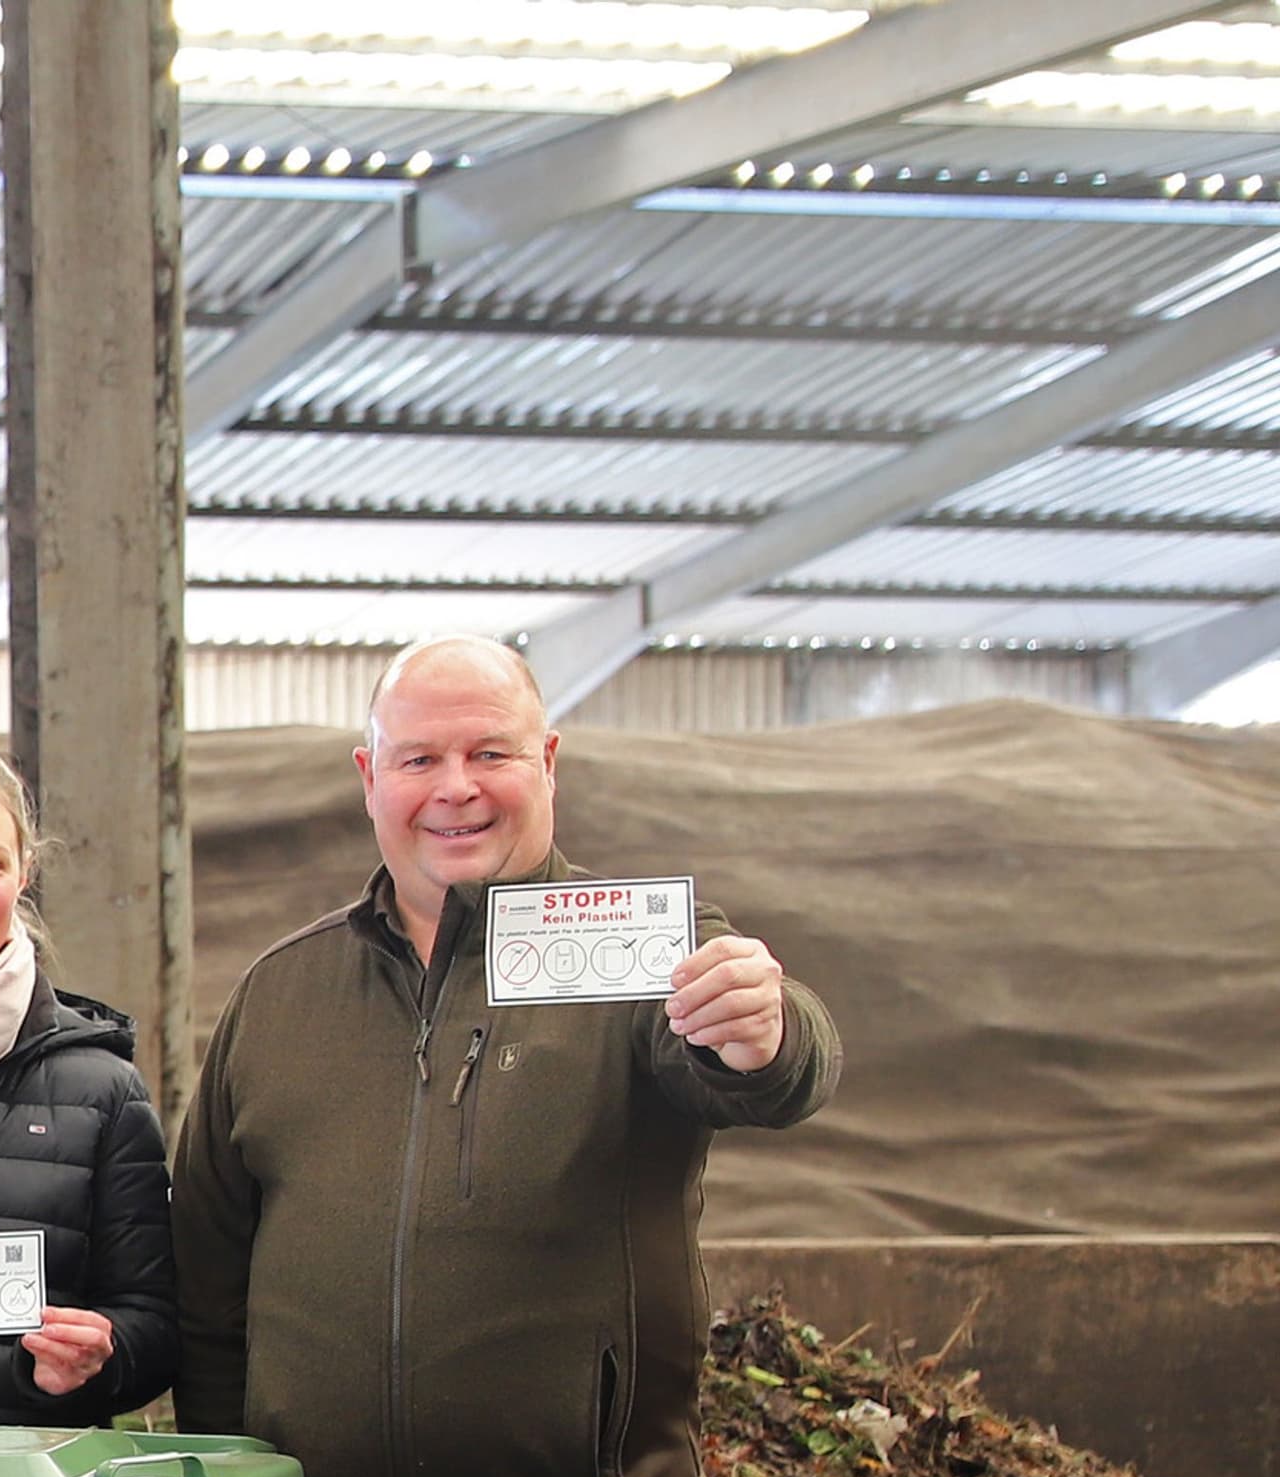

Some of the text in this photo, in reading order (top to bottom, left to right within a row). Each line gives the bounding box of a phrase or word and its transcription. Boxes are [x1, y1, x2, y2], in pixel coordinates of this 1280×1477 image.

[544, 890, 631, 909] STOPP!
[542, 910, 632, 925] Kein Plastik!
